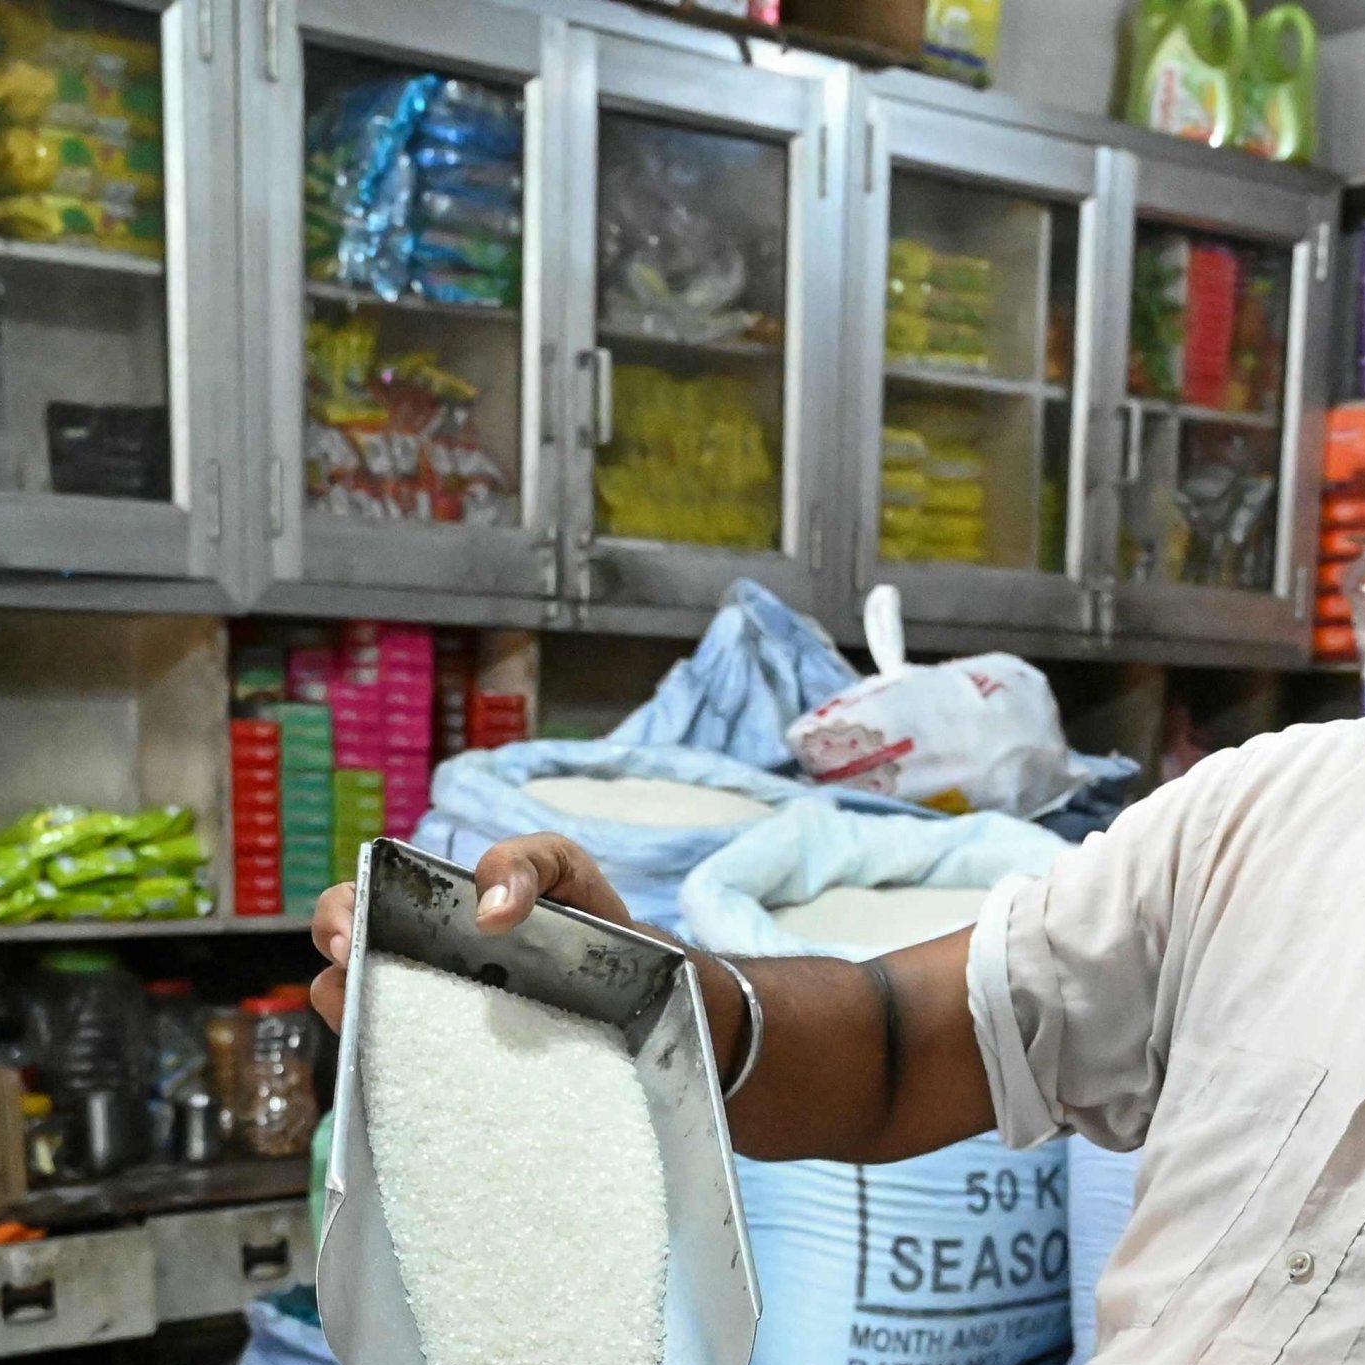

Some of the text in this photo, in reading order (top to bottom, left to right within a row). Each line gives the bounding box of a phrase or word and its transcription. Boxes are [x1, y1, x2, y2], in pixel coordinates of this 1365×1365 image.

[965, 1171, 1021, 1216] 50
[849, 1323, 945, 1354] MONTH
[951, 1321, 998, 1351] AND
